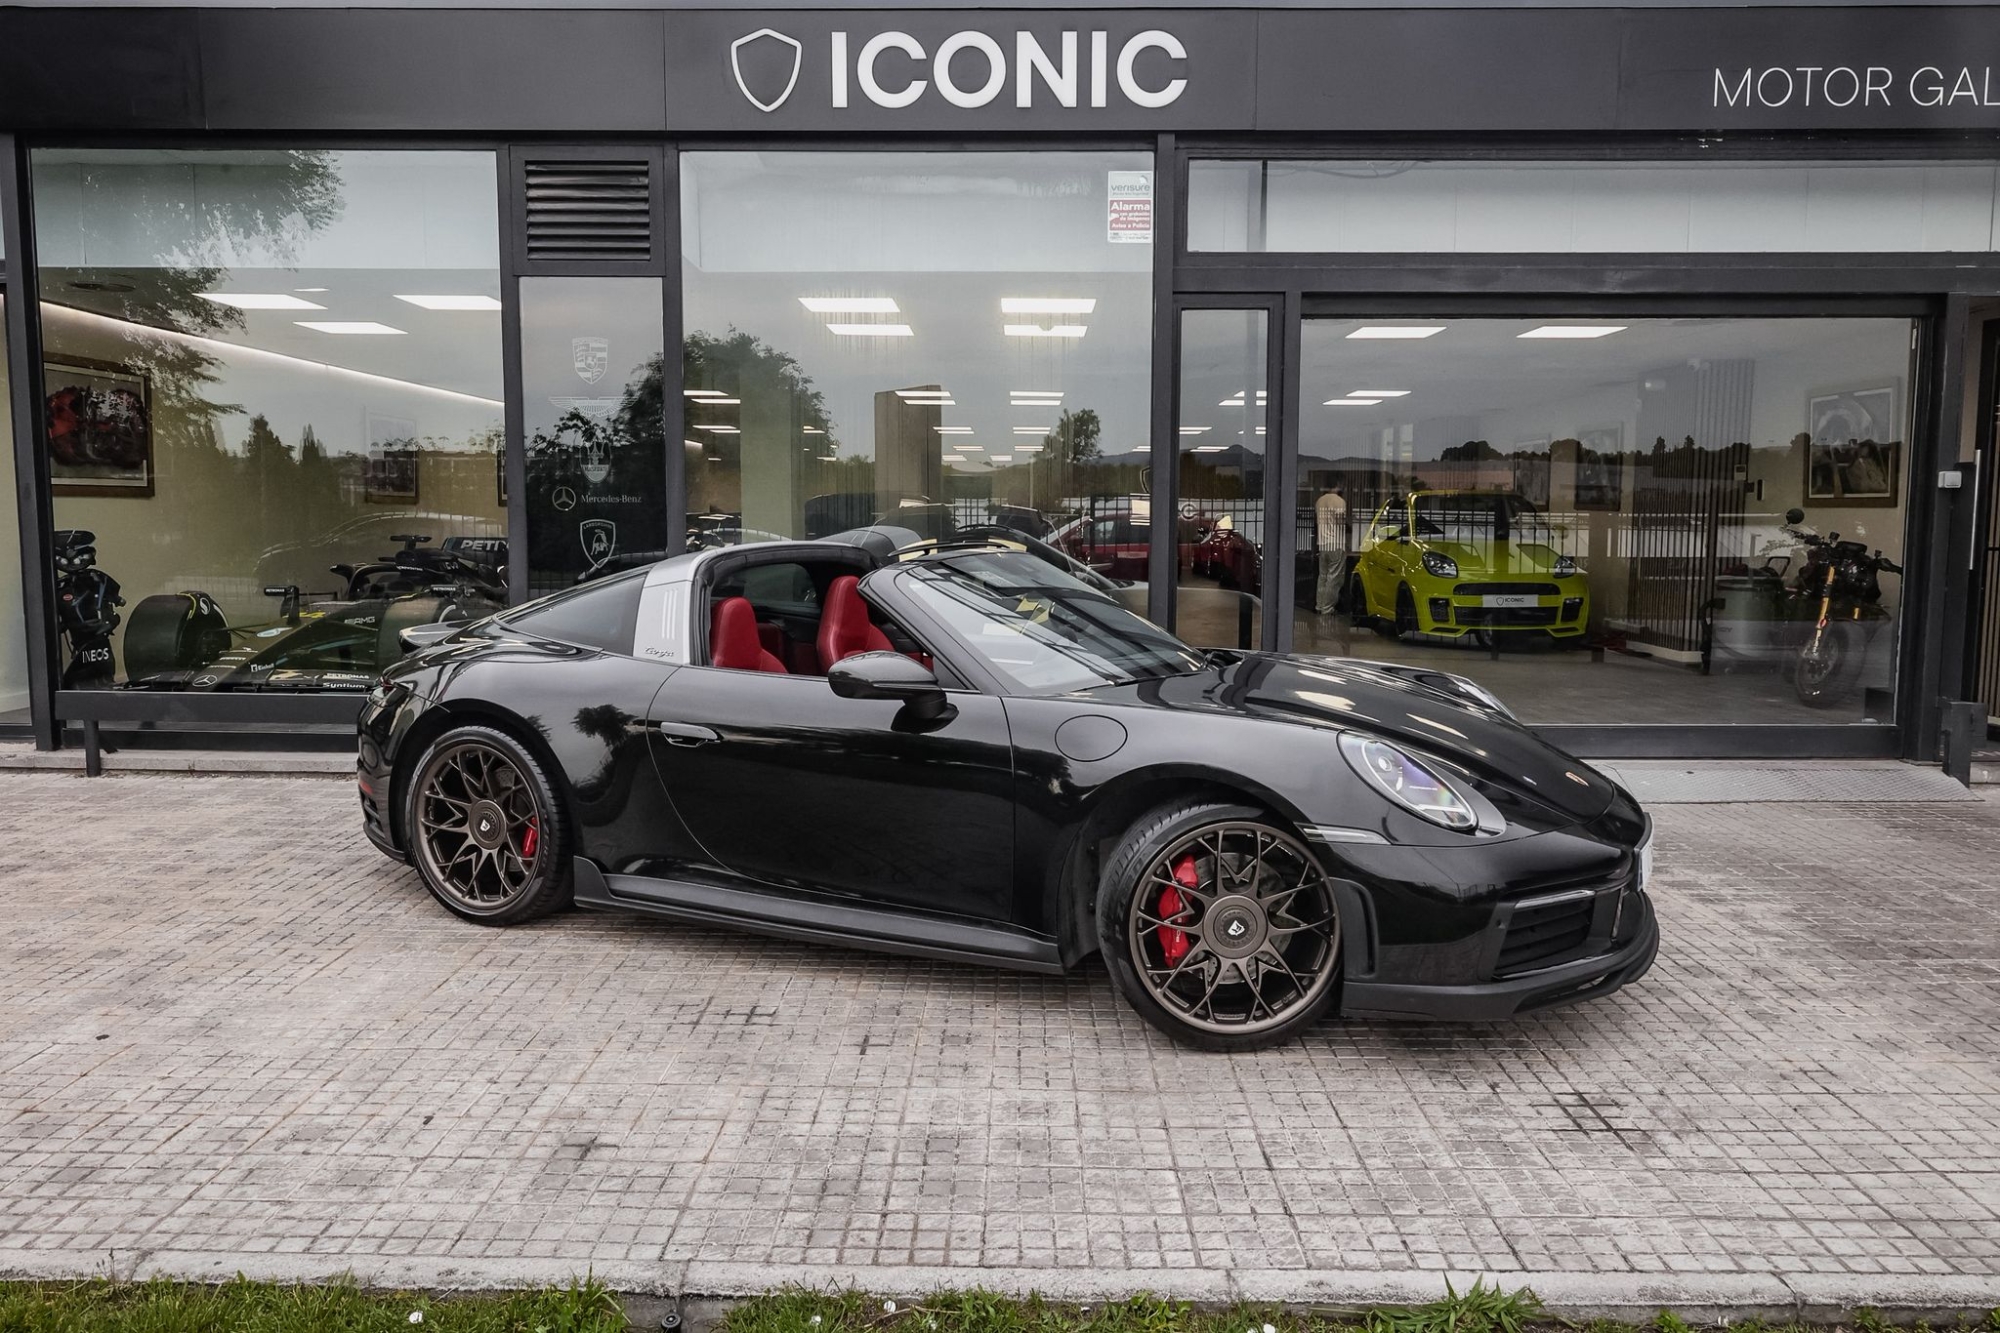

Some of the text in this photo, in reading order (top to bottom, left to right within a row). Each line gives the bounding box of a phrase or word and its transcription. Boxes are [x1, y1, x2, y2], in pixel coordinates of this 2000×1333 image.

[831, 30, 1188, 109] ICONIC
[1713, 66, 2000, 108] MOTOR GAL
[1111, 201, 1150, 211] Alarma
[581, 494, 642, 503] Mercedes-Benz
[82, 647, 109, 664] INEOS
